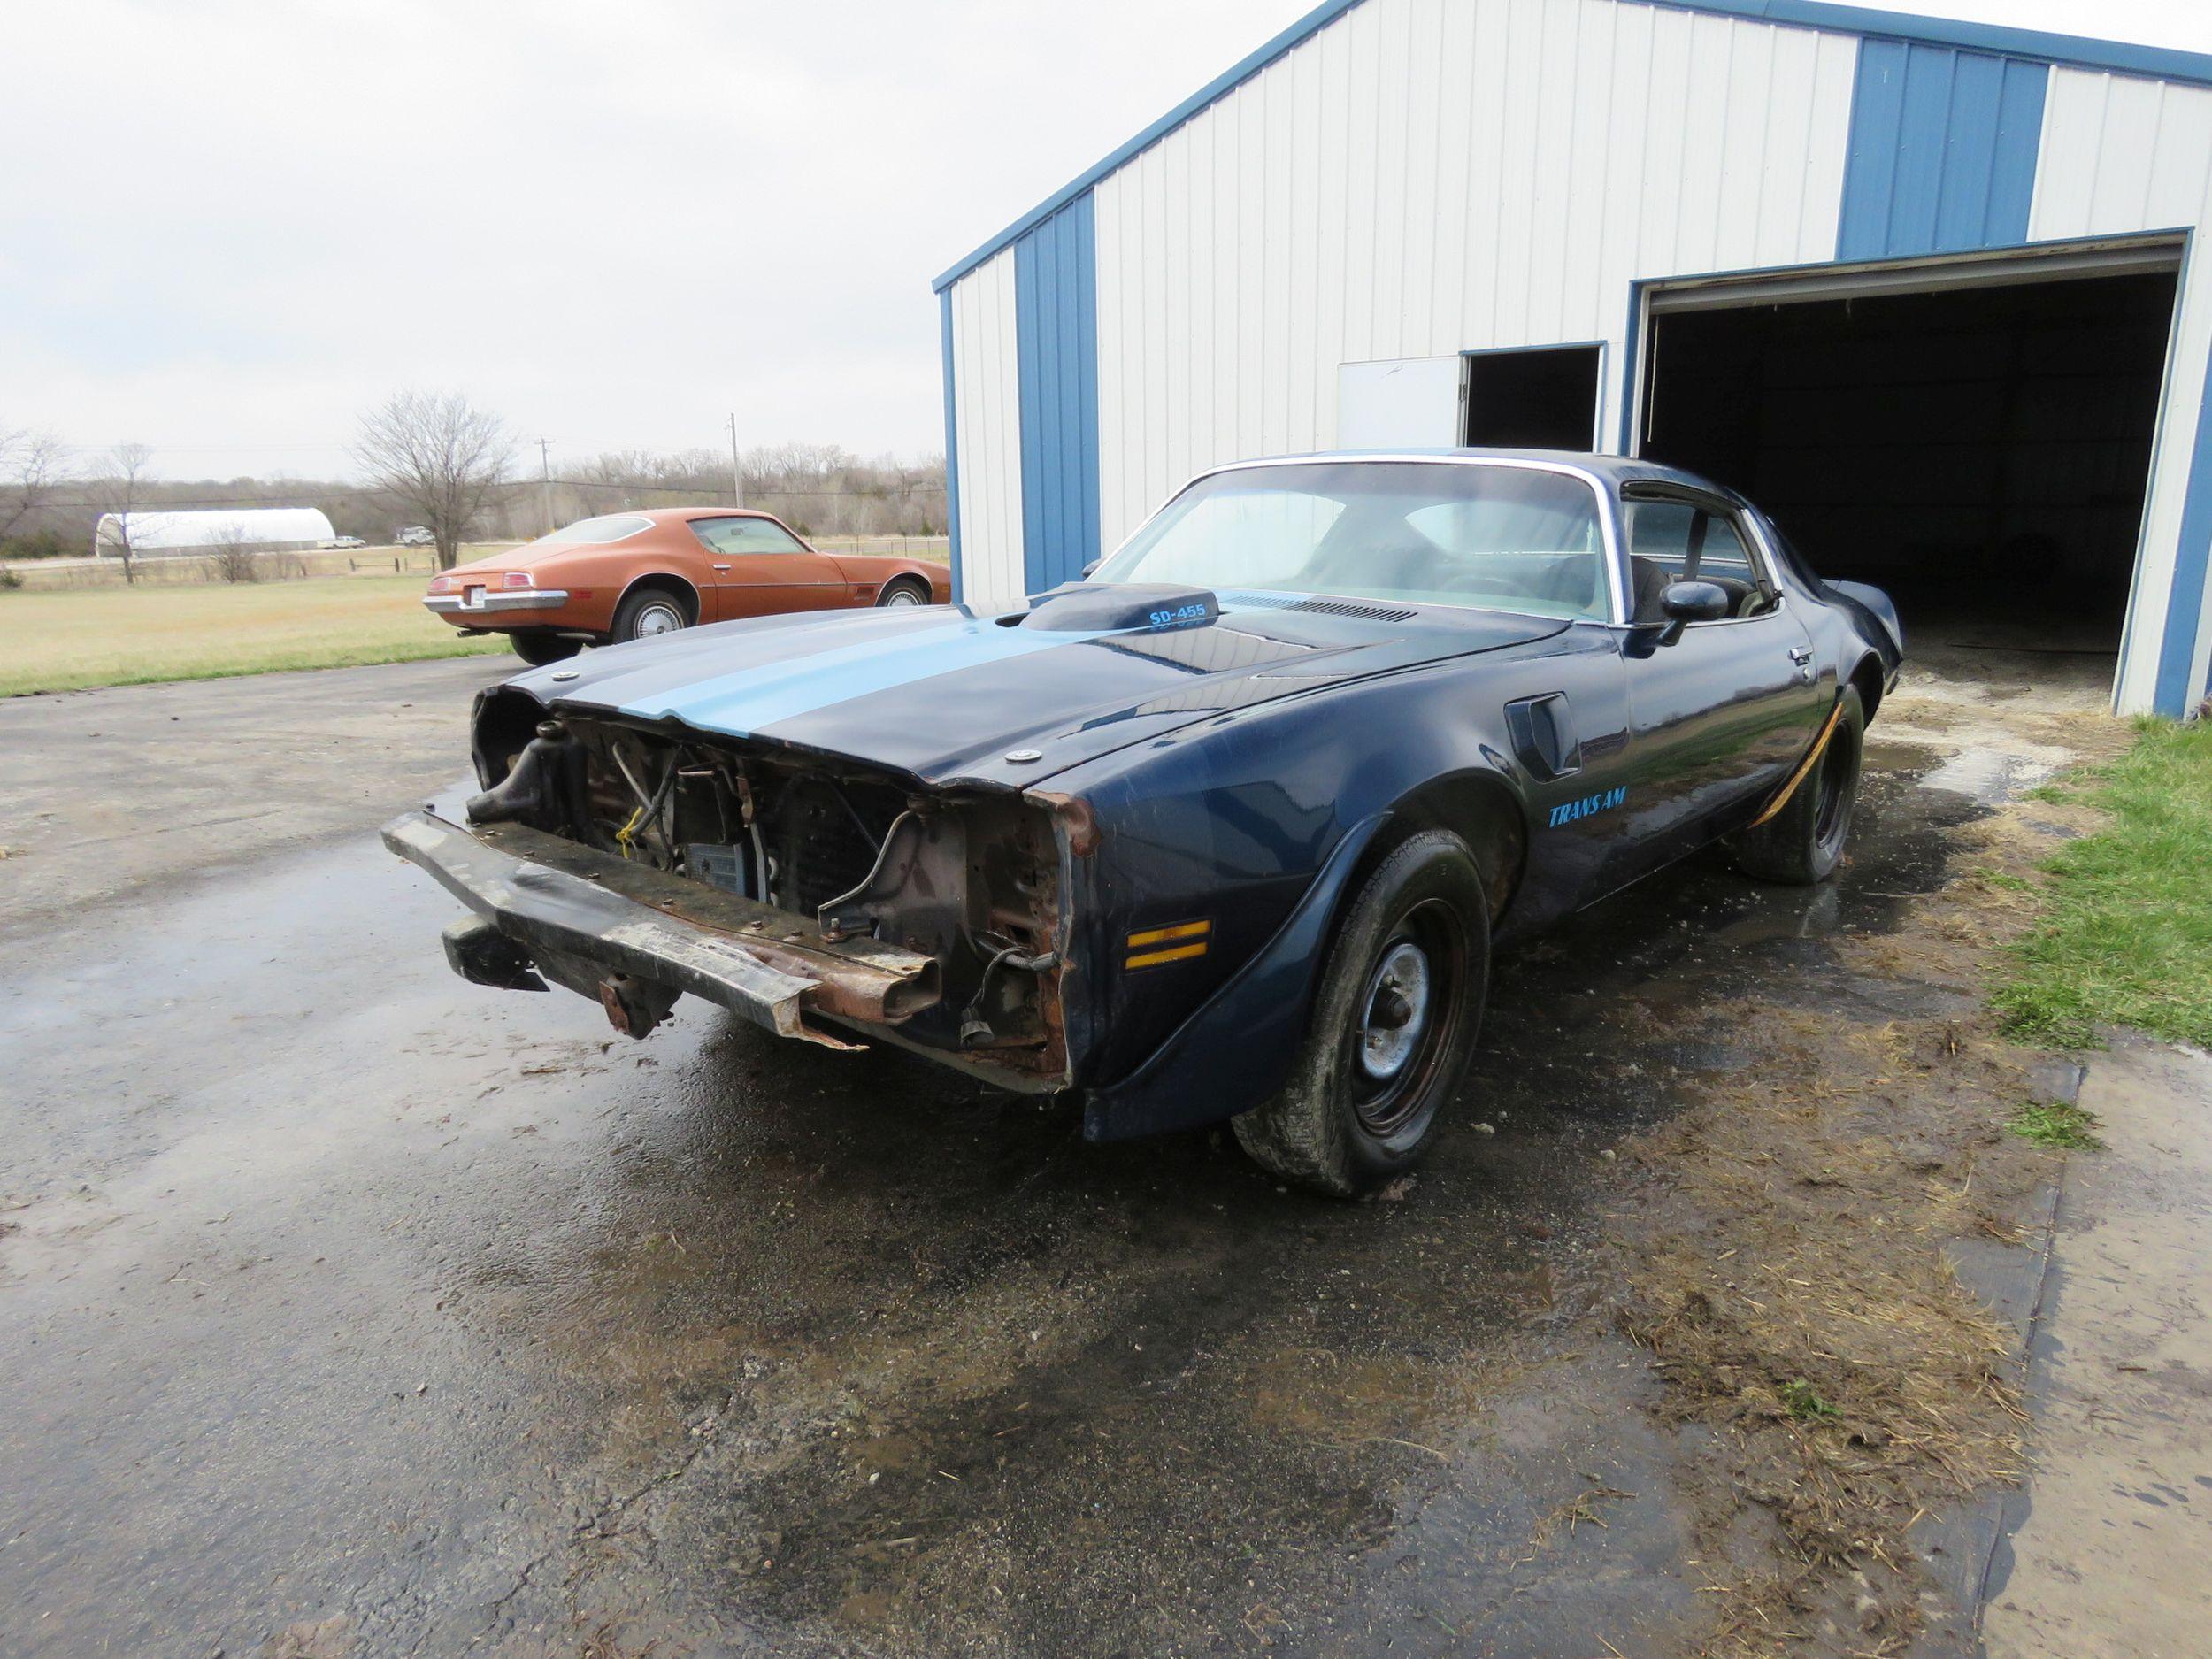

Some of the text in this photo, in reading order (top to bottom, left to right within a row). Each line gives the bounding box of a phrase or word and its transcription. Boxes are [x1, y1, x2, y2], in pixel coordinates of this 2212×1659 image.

[1150, 603, 1206, 625] SD-455
[1549, 786, 1627, 828] TRANS AM
